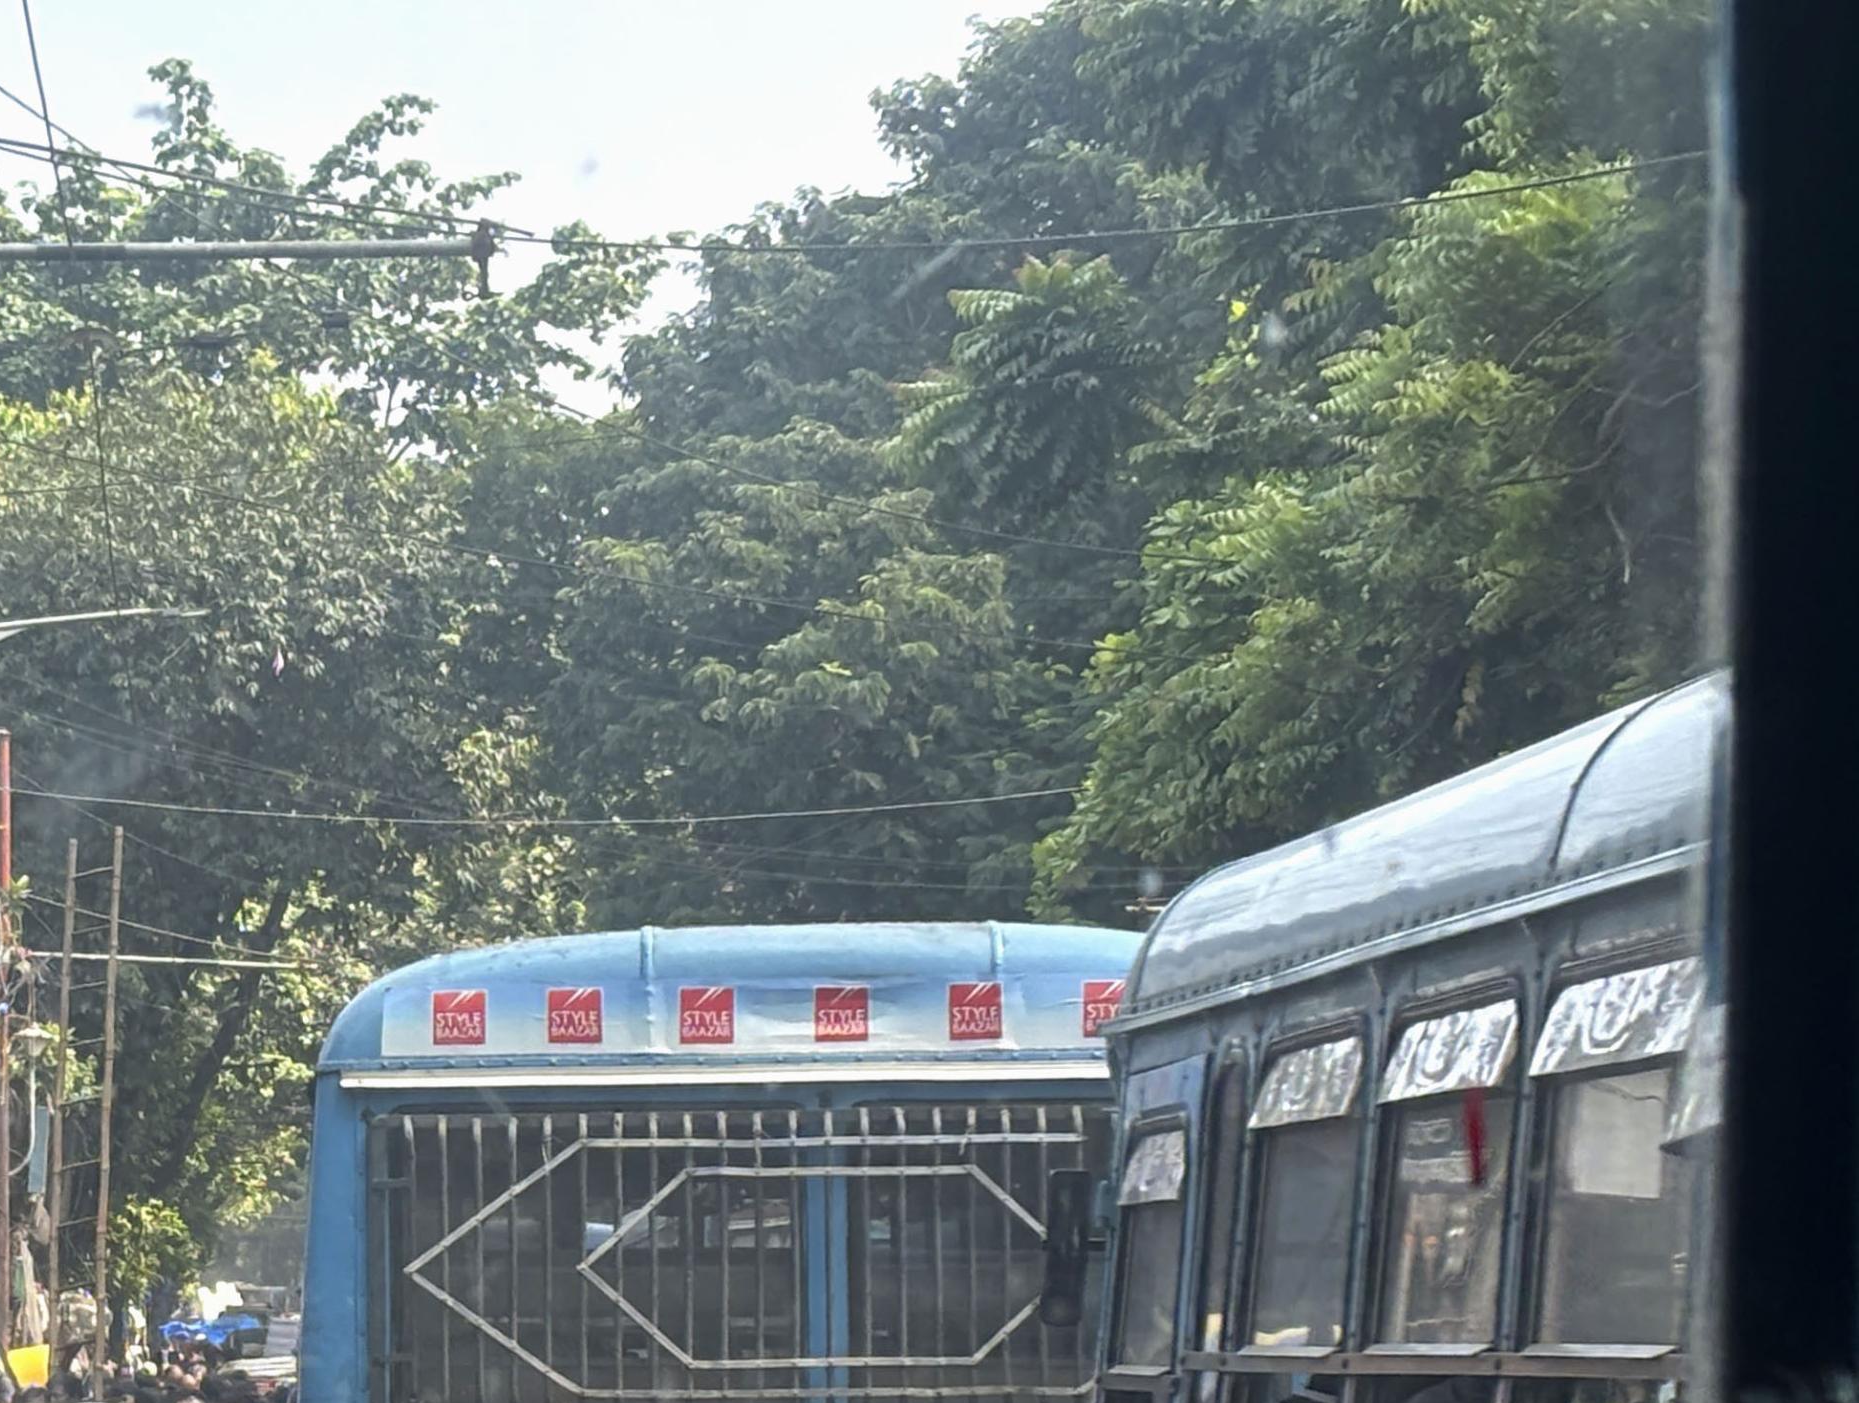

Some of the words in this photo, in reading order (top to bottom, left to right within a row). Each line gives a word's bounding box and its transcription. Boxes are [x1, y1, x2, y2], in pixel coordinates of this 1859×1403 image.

[551, 1011, 599, 1026] STYLE
[683, 1010, 731, 1026] STYLE
[818, 1009, 866, 1024] STYLE
[953, 1006, 1000, 1021] STYLE
[1086, 1003, 1122, 1019] STY
[436, 1013, 482, 1027] STYLE
